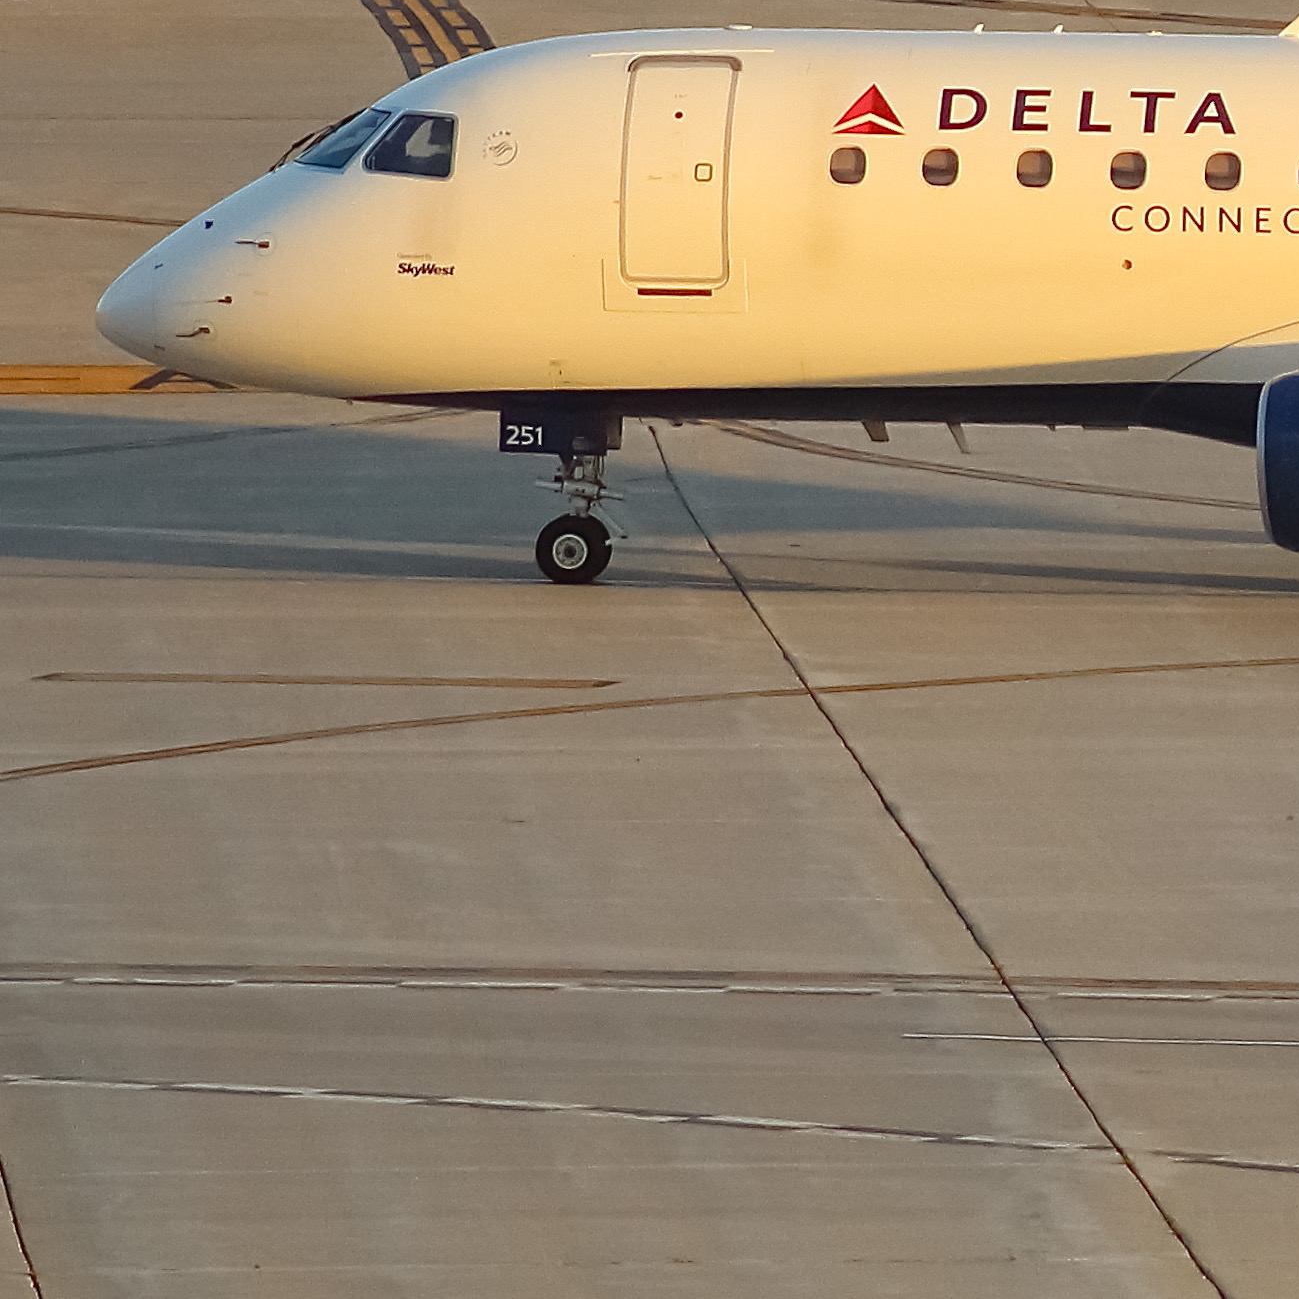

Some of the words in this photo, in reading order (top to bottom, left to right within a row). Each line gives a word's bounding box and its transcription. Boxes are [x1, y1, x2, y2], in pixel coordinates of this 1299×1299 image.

[937, 88, 1237, 135] DELTA
[397, 262, 455, 278] SkyWest
[505, 425, 544, 447] 251
